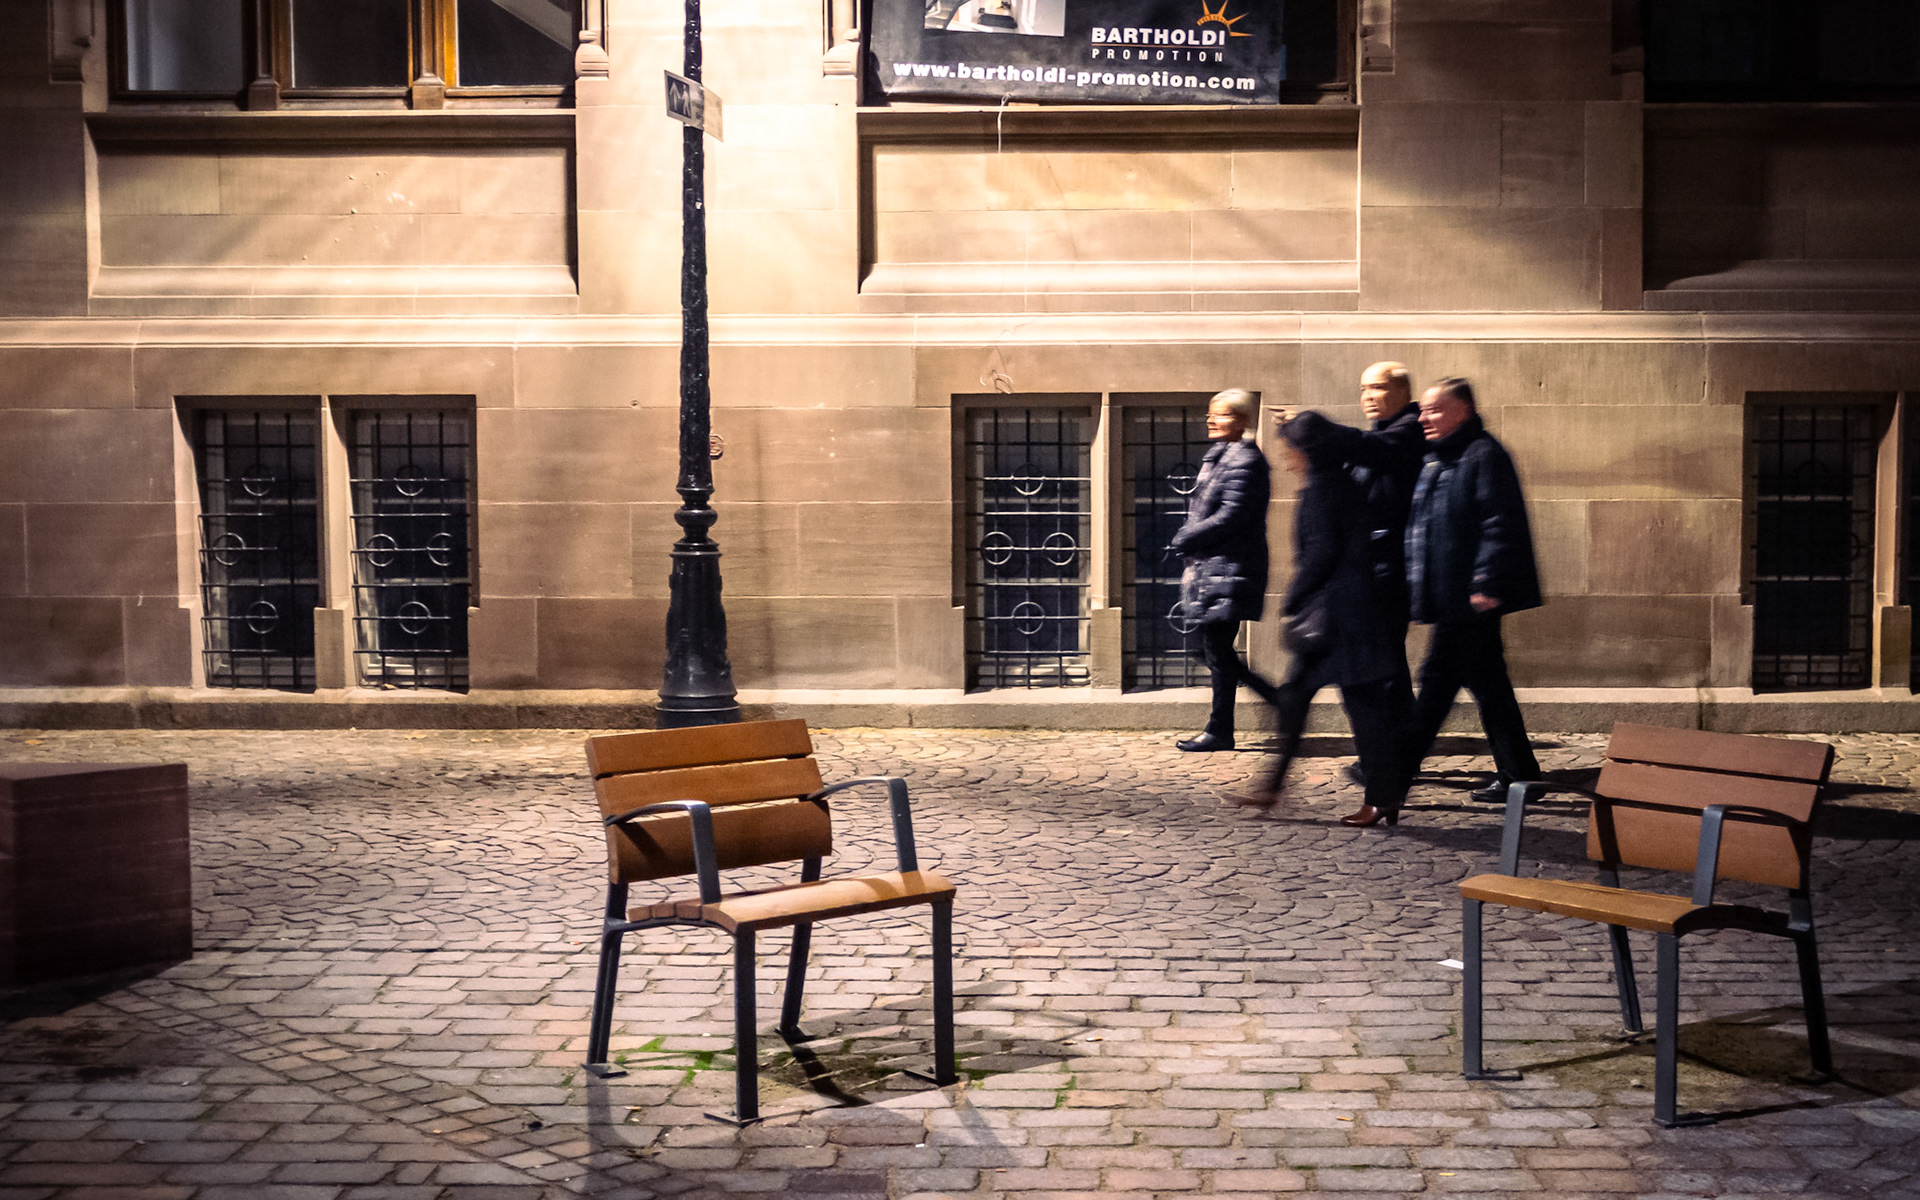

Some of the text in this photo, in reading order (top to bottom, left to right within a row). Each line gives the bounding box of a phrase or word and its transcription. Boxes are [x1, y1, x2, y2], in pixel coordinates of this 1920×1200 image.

[1091, 27, 1226, 46] BARTHOLDI
[1091, 48, 1223, 62] PROMOTION
[892, 61, 1256, 90] www.bartholdi-promotion.com
